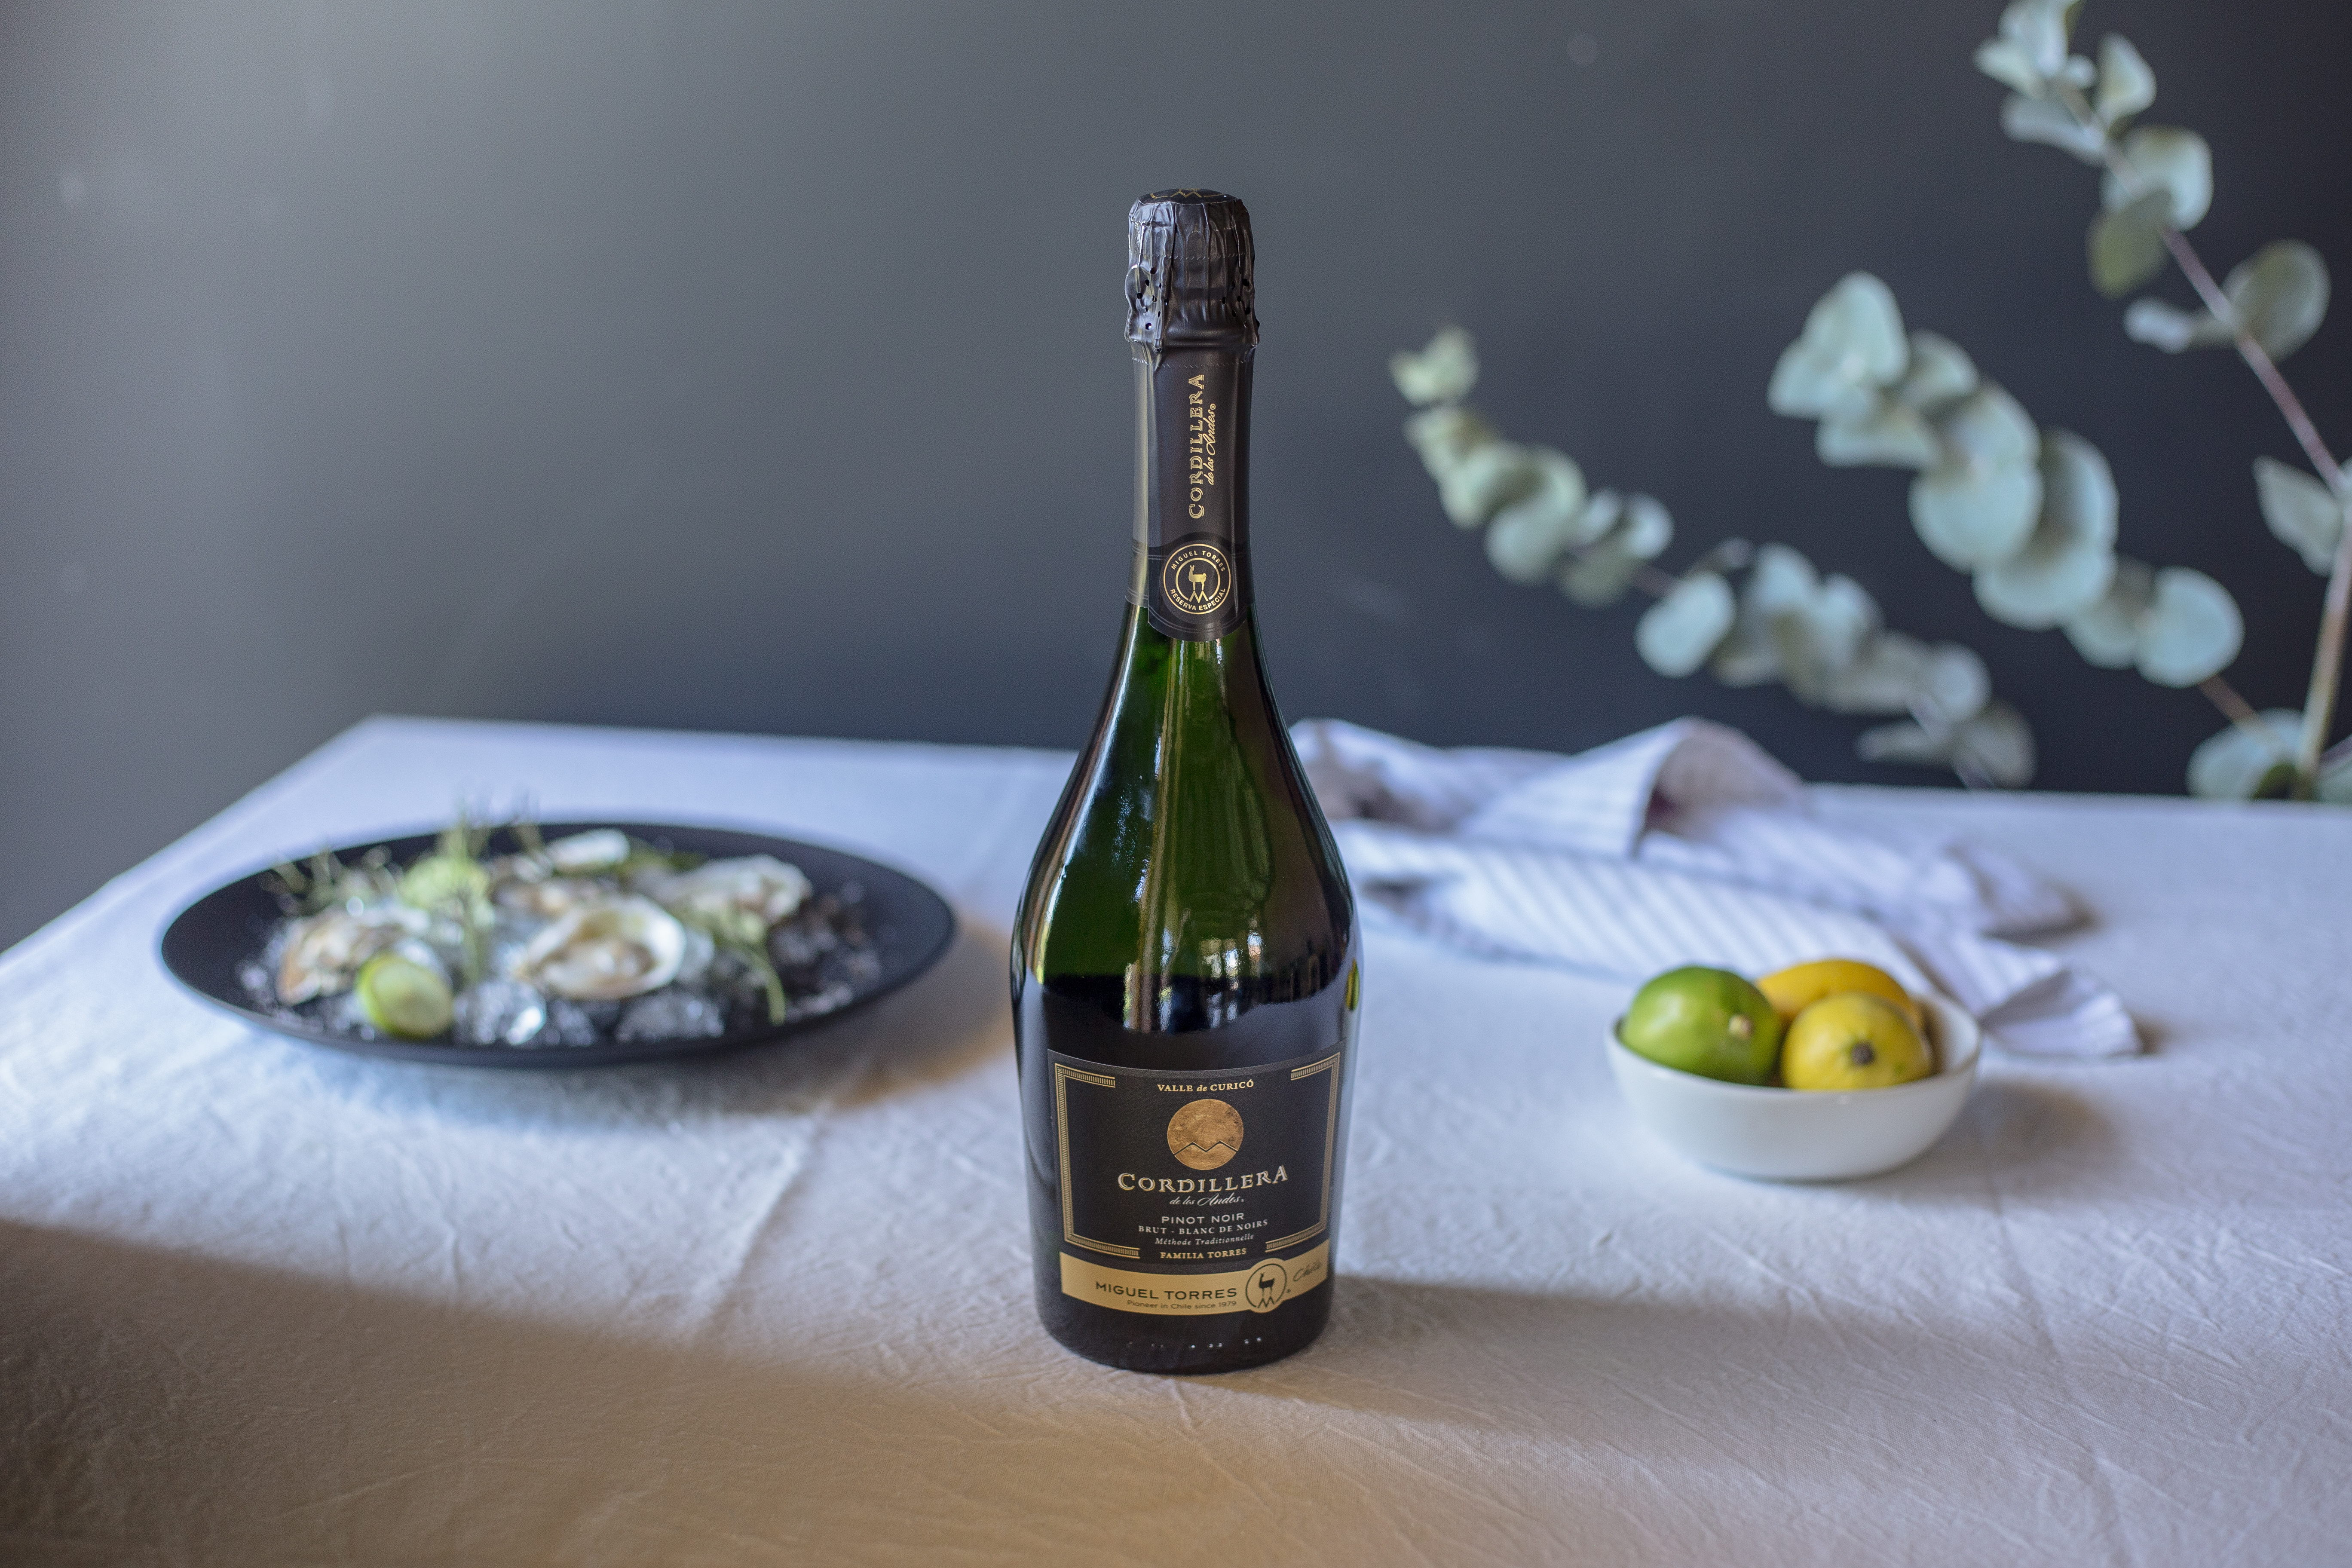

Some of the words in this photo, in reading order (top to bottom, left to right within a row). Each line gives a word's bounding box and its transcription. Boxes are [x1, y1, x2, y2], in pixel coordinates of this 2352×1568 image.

[1188, 374, 1204, 518] CORDILLERA
[1203, 457, 1214, 471] los
[1204, 472, 1214, 485] de
[1171, 550, 1198, 570] MIGUEL
[1202, 550, 1225, 572] TORRES
[1170, 588, 1196, 611] RESERVA
[1198, 588, 1225, 611] ESPECIAL
[1210, 1079, 1254, 1091] CURICÓ
[1118, 1165, 1288, 1192] CORDILLERA
[1170, 1196, 1181, 1204] de
[1211, 1213, 1244, 1223] NOIR
[1139, 1225, 1167, 1234] BRUT
[1237, 1219, 1268, 1231] NOIRS
[1195, 1233, 1254, 1245] Traditionnelle
[1207, 1248, 1246, 1258] TORRES
[1096, 1281, 1159, 1299] MIGUEL
[1164, 1288, 1237, 1300] TORRES
[1127, 1300, 1158, 1308] Pioneer
